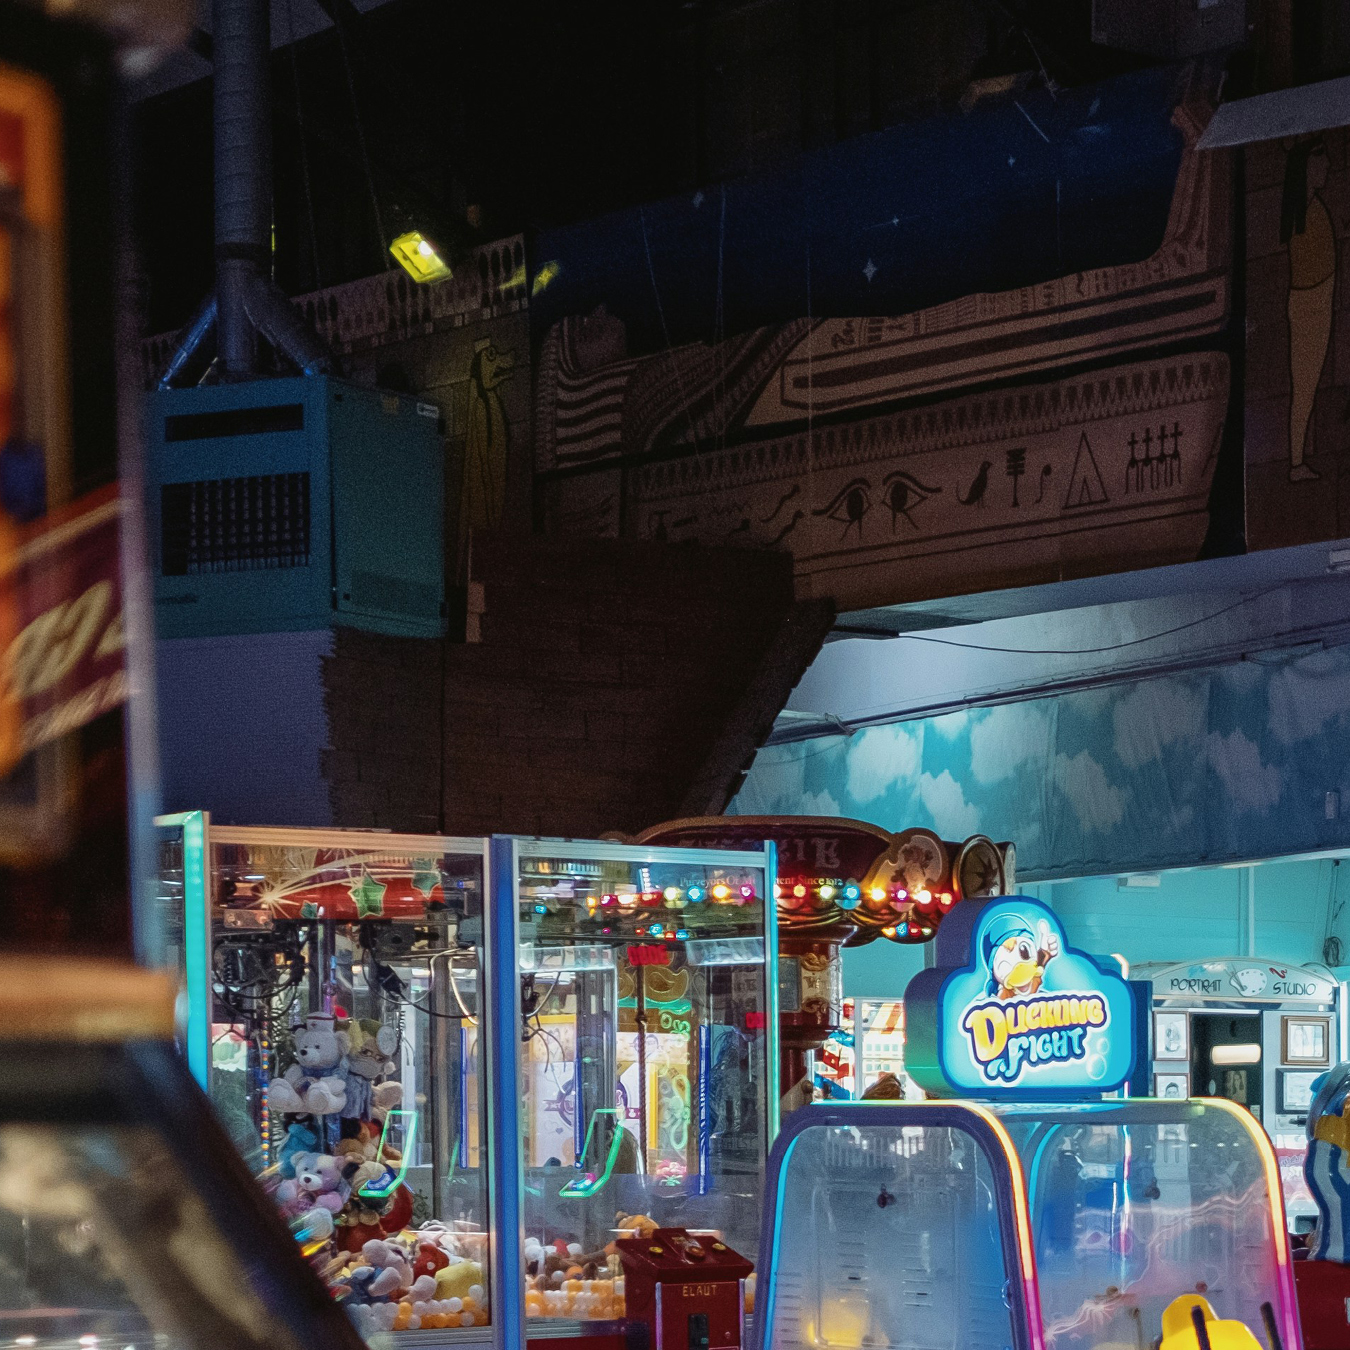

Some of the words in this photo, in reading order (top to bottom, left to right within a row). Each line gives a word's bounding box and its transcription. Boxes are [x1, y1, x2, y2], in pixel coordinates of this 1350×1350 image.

[1170, 977, 1221, 993] PORTRAIT
[1273, 981, 1317, 995] STUDIO
[682, 1284, 717, 1297] ELAUT
